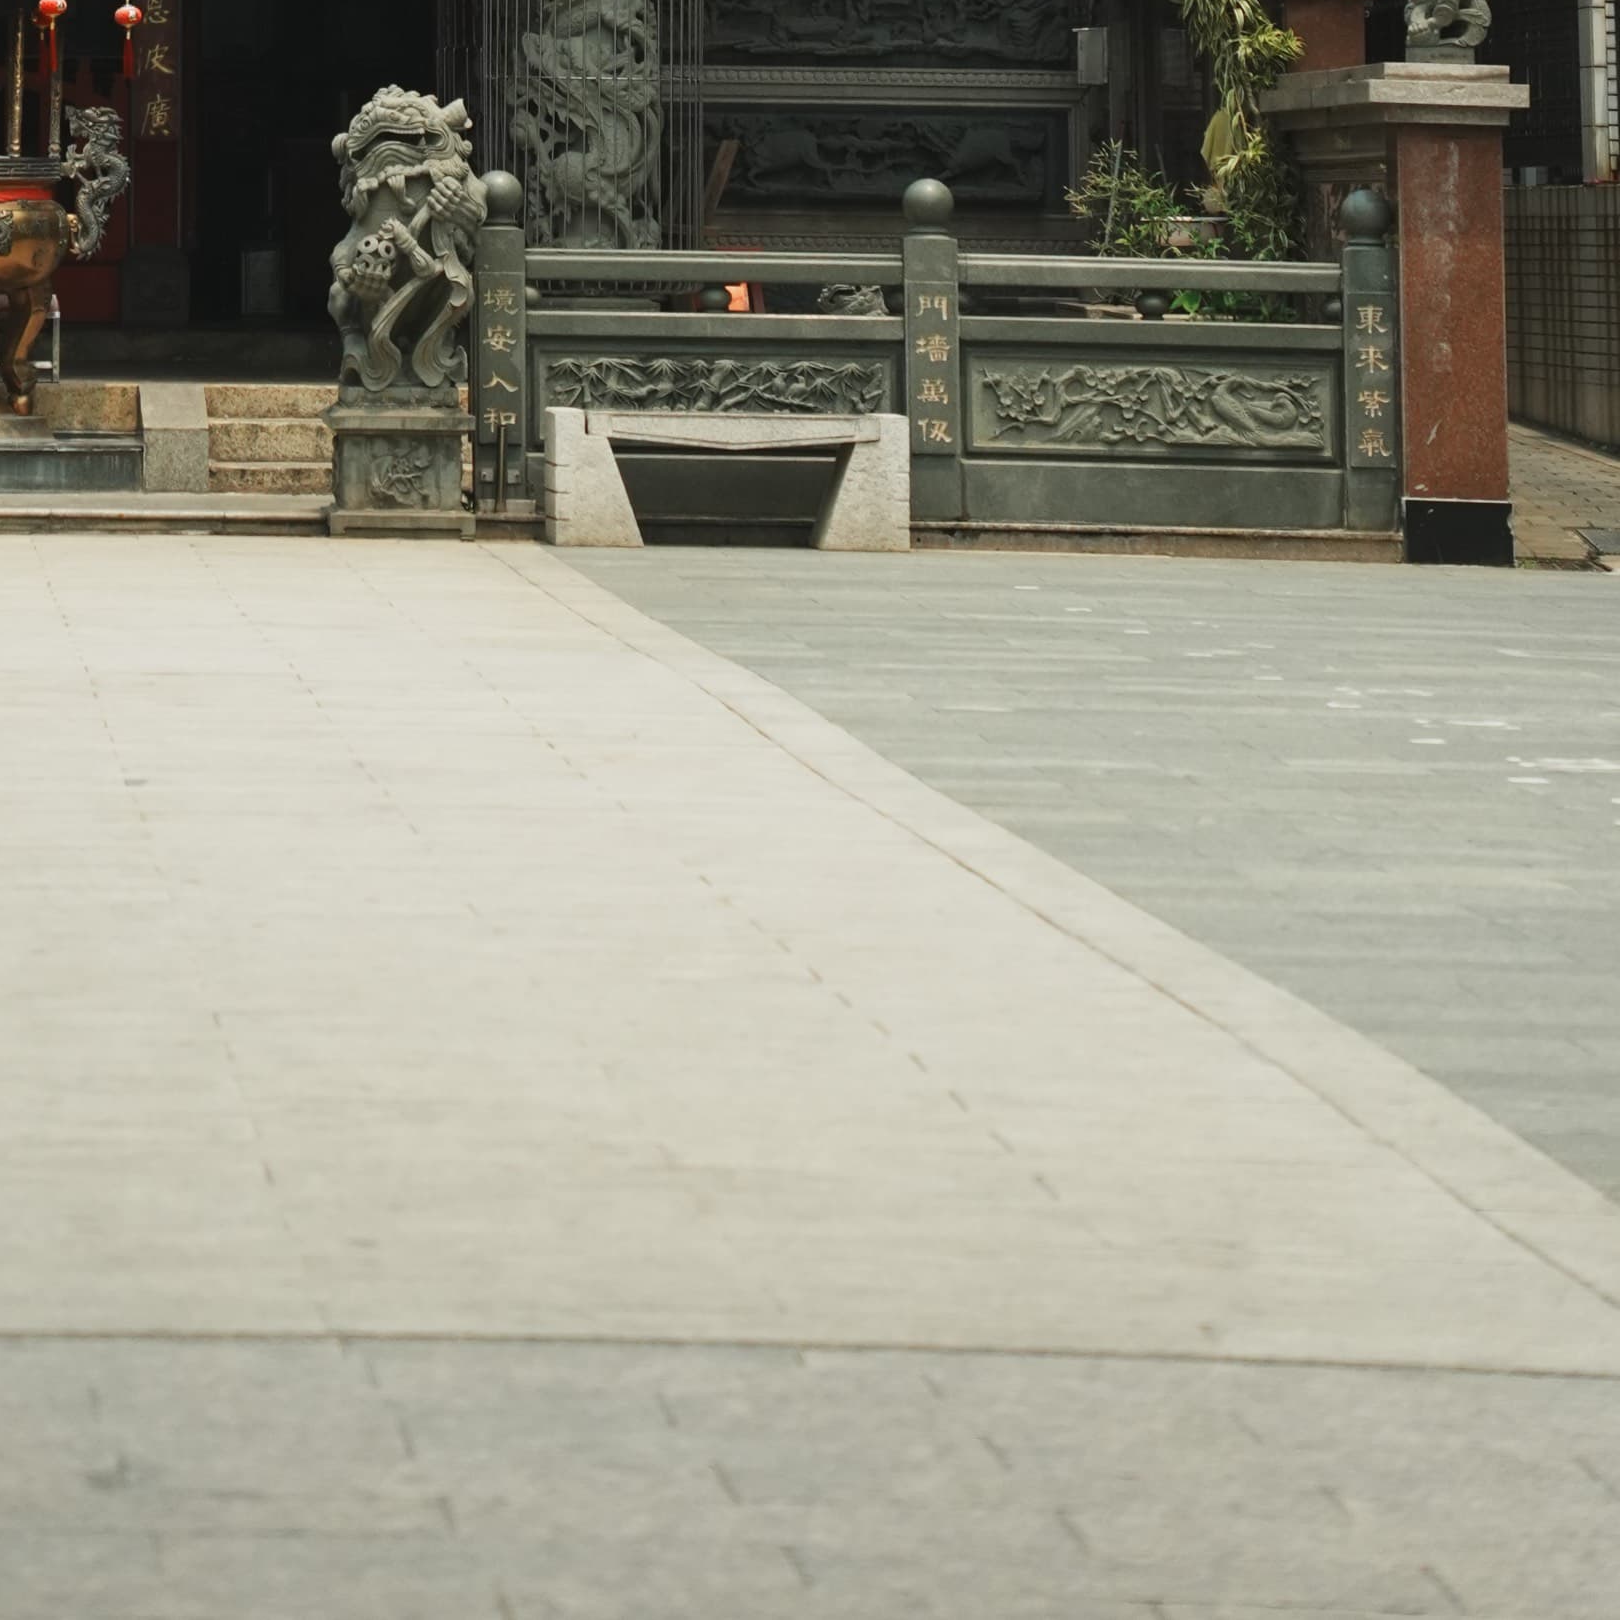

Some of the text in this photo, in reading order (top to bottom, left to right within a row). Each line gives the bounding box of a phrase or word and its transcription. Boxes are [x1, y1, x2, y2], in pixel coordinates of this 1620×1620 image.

[482, 287, 520, 434] 境安人和
[1355, 303, 1393, 458] 東來紫氣
